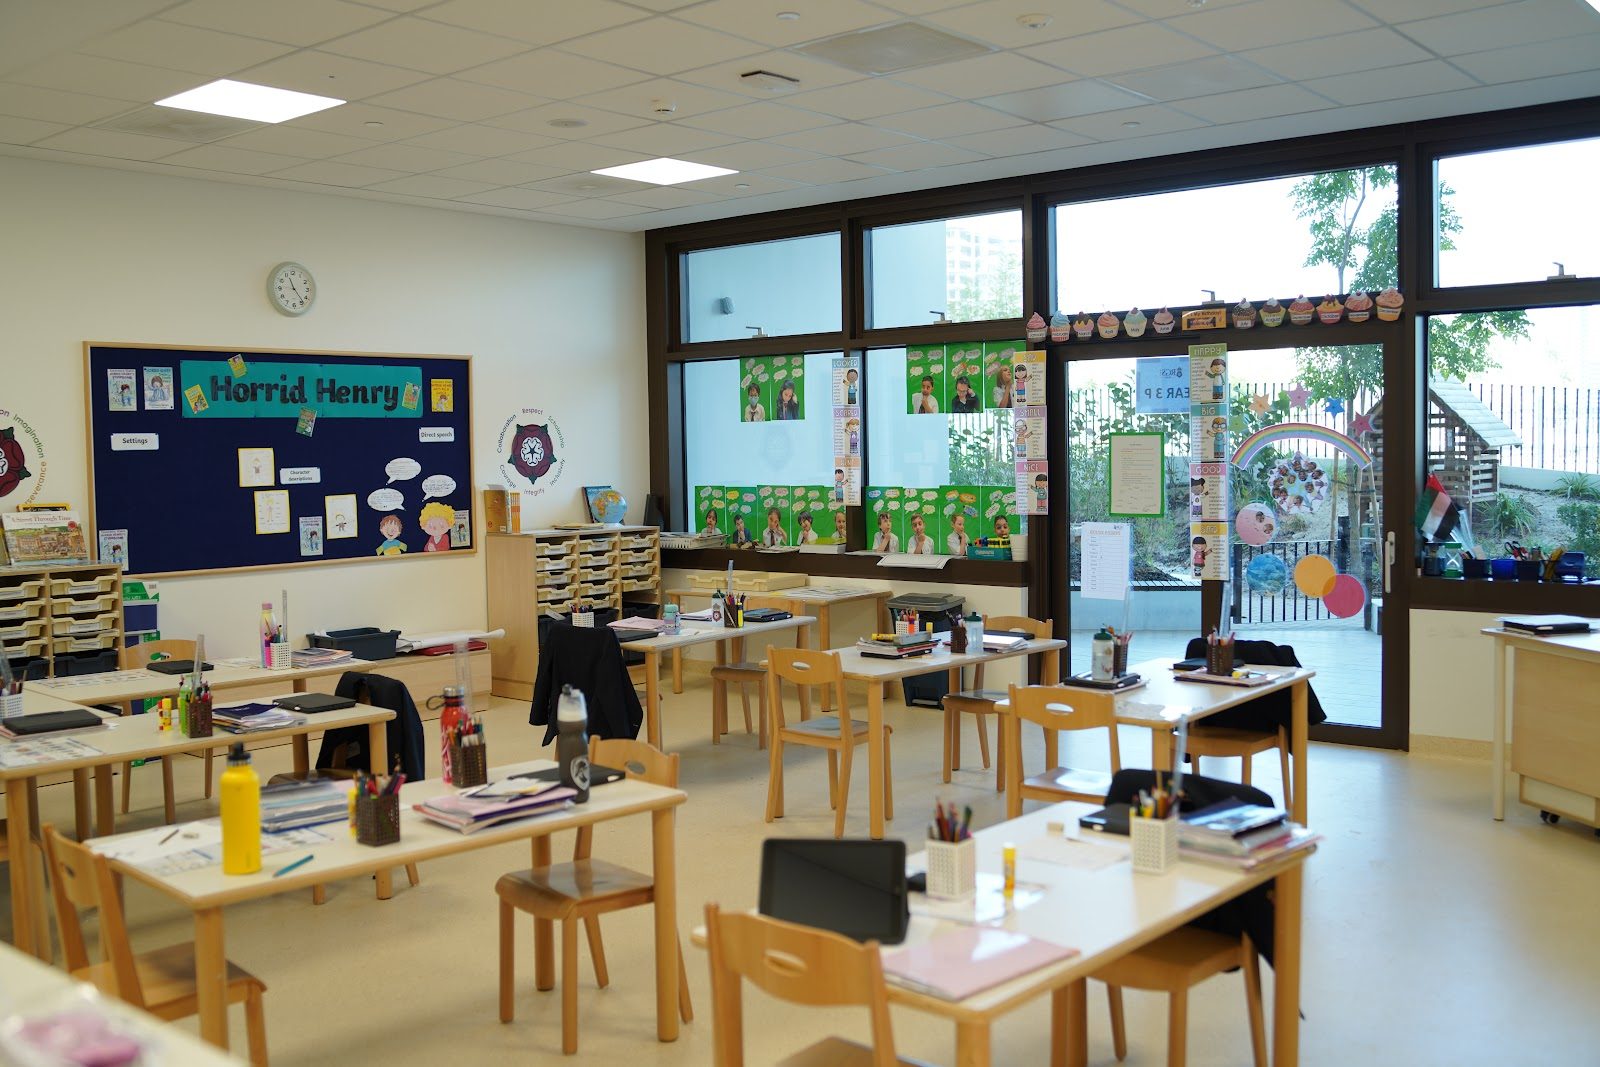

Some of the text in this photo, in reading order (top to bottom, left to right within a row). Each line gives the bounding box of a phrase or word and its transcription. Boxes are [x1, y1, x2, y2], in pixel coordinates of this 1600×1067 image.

[210, 374, 399, 411] Horrid Henry
[1020, 408, 1040, 417] SMALL
[13, 414, 45, 458] Imagination
[122, 437, 148, 445] Settings
[497, 414, 517, 453] Collaboration
[548, 415, 565, 448] Scholarship
[500, 464, 517, 489] Courage
[1195, 465, 1221, 474] GOOD
